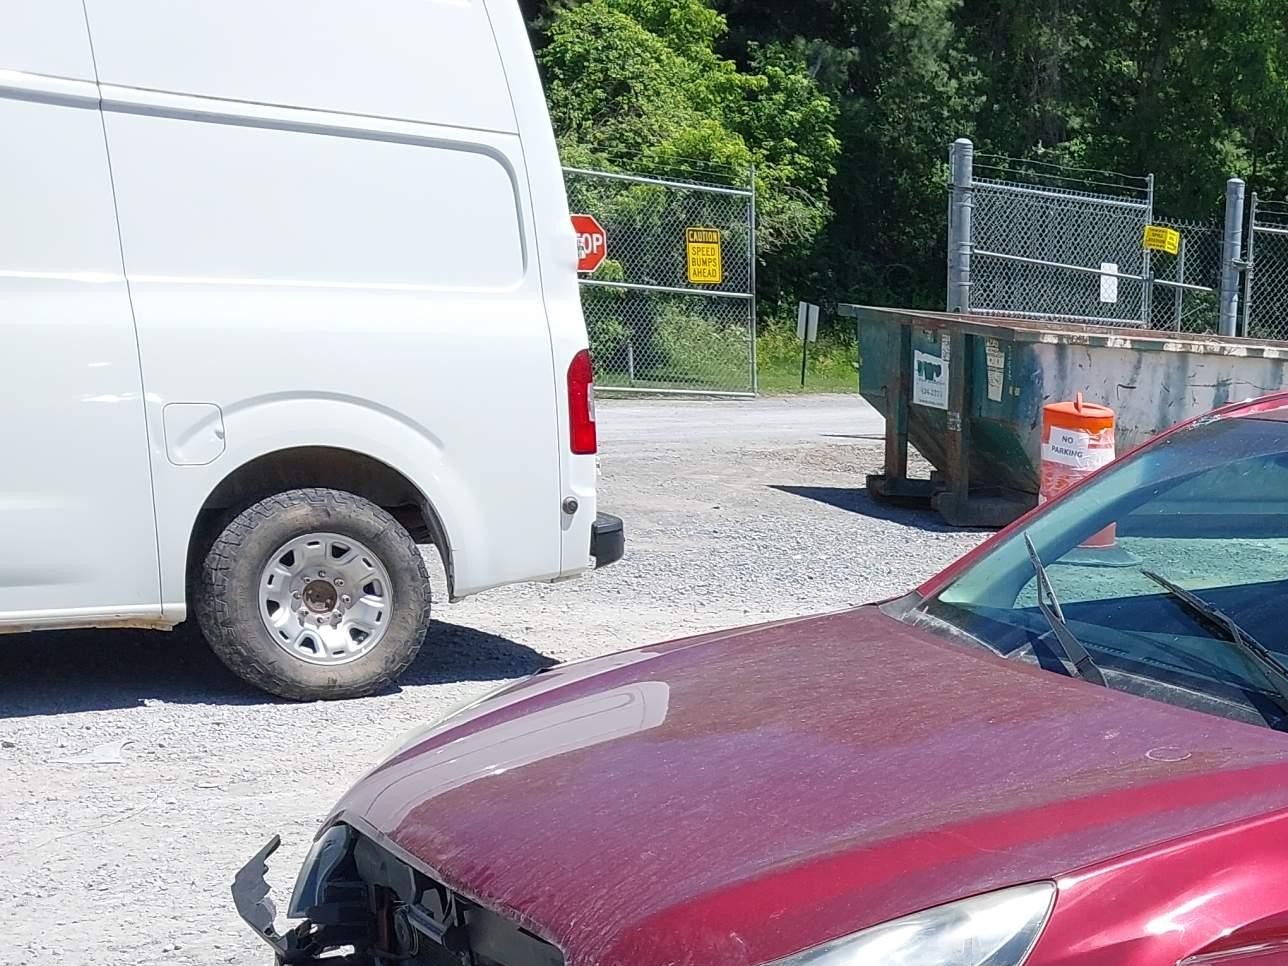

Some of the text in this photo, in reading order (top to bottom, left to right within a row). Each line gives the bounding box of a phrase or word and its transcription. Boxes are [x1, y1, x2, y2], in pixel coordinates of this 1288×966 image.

[689, 231, 718, 242] CAUTION
[576, 233, 603, 254] OP
[691, 246, 716, 256] SPEED
[691, 257, 717, 267] BUMPS
[692, 268, 717, 278] AHEAD
[1062, 435, 1074, 444] NO
[1051, 445, 1083, 458] PARKING
